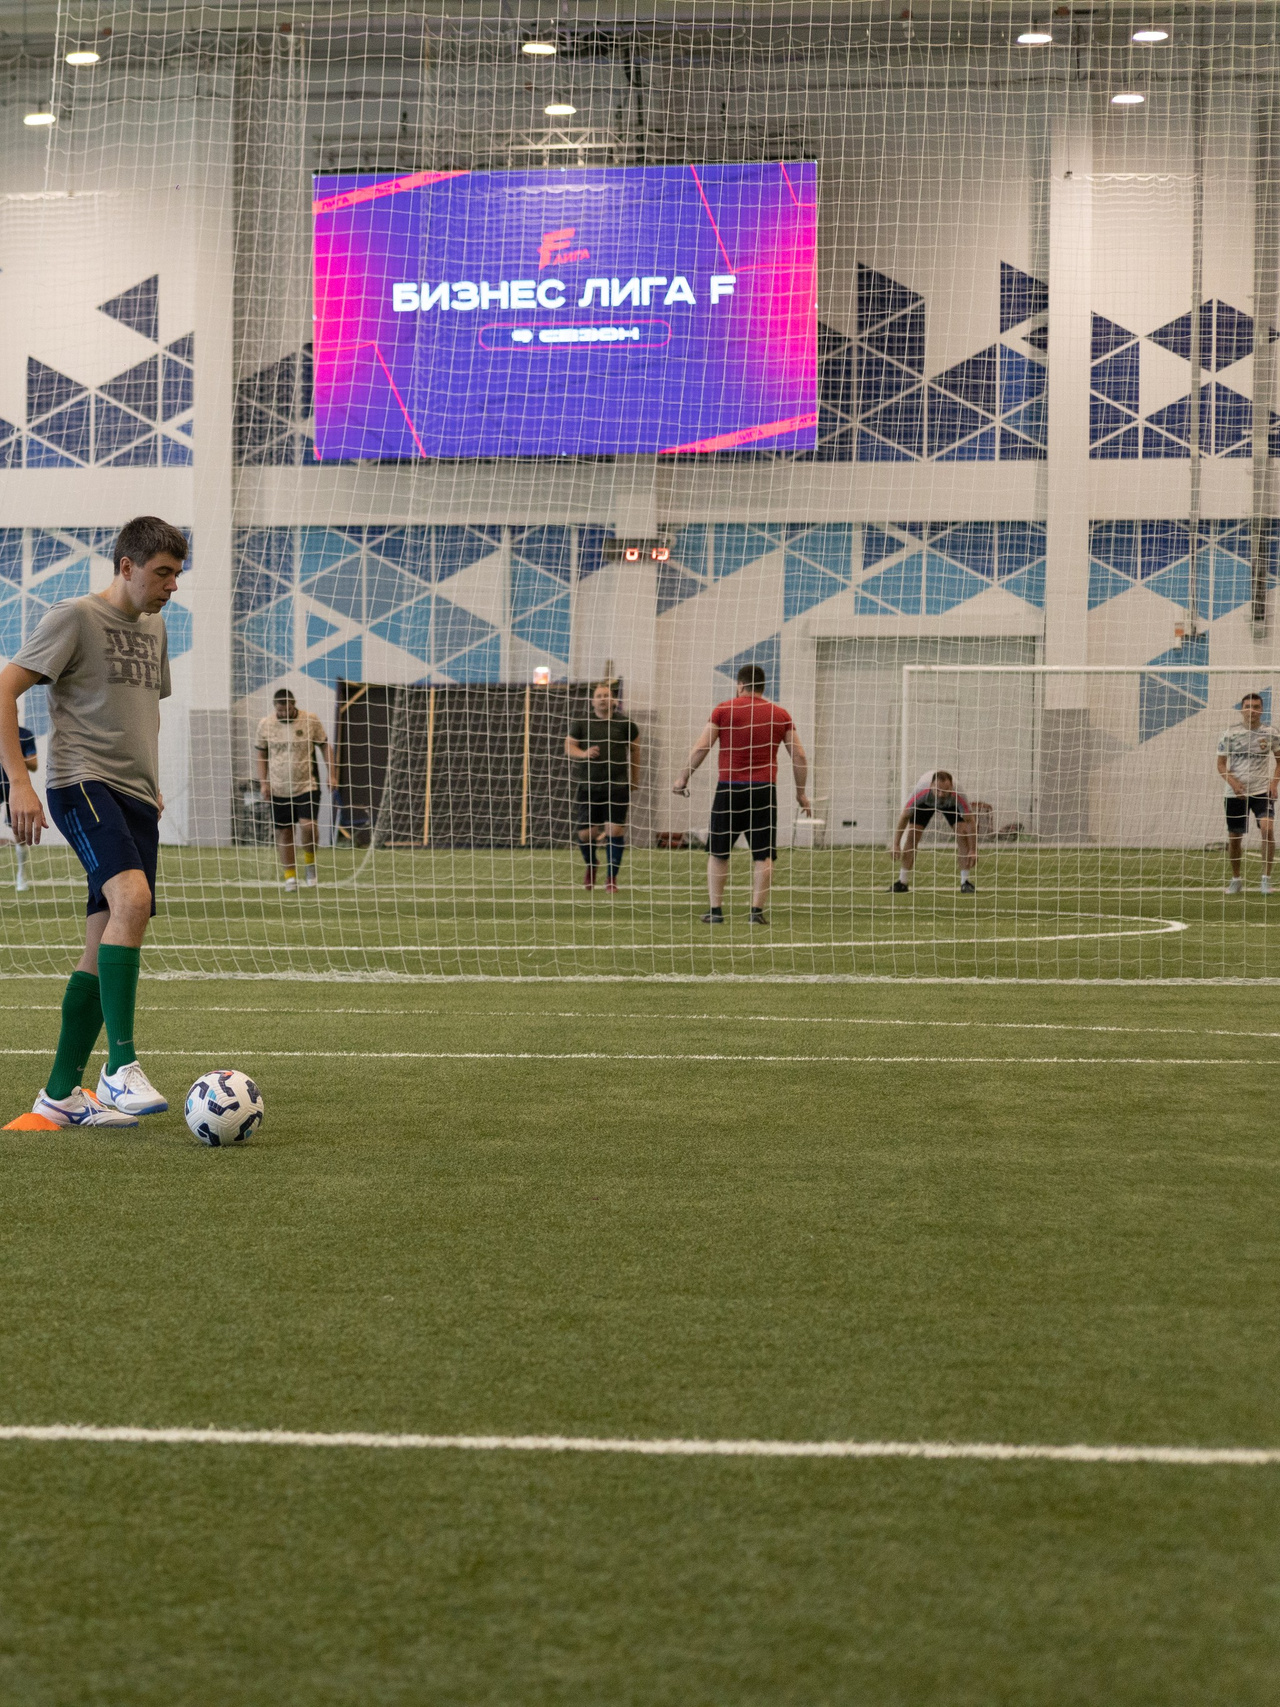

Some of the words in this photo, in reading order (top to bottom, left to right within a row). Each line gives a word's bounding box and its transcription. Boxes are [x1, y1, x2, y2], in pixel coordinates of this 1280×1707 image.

[392, 279, 566, 312] БИЗНЕС
[578, 276, 696, 307] ЛИГА
[710, 275, 736, 304] F
[538, 326, 640, 343] СЕЗОН
[104, 628, 158, 662] JUST
